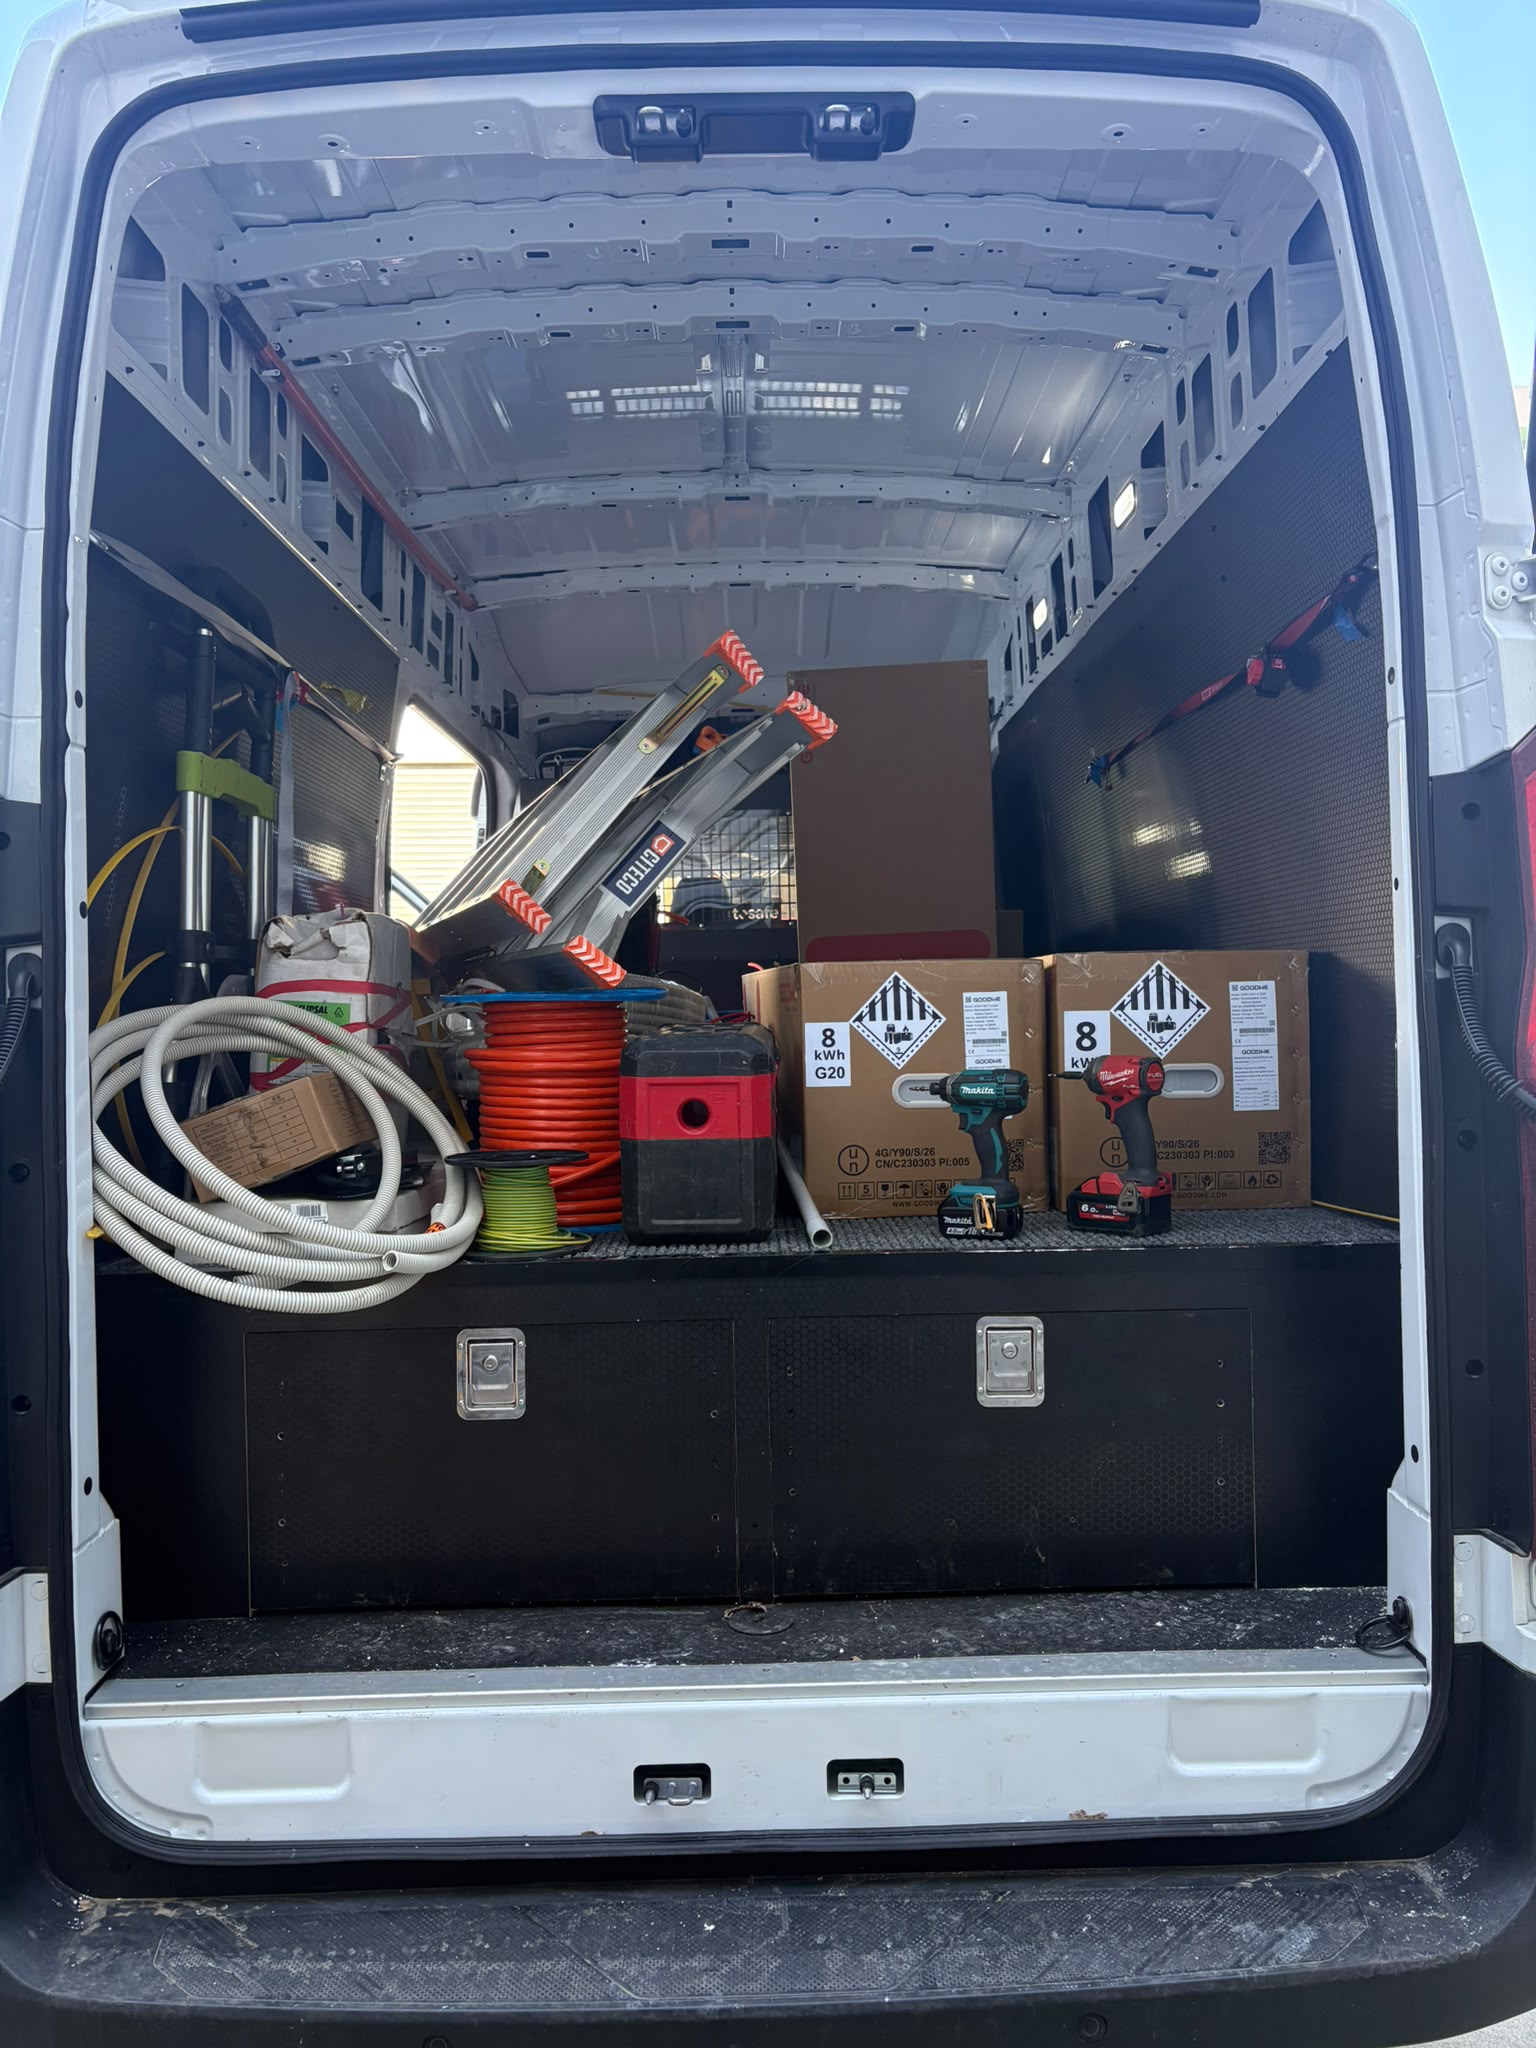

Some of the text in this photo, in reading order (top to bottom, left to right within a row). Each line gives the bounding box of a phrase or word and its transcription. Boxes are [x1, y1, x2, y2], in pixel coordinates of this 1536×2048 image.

[615, 848, 661, 895] CITECO
[821, 1028, 836, 1048] 8
[1075, 1021, 1098, 1051] 8
[814, 1049, 845, 1061] kWh
[1071, 1056, 1094, 1069] kW
[815, 1066, 845, 1080] G20
[1099, 1068, 1135, 1082] Milwaukee
[1155, 1139, 1200, 1149] Y90/S/26
[875, 1147, 936, 1158] 4G/Y90/S/26
[1157, 1149, 1235, 1160] C230303 PI:003
[875, 1157, 970, 1168] CN/C230303 PI:005
